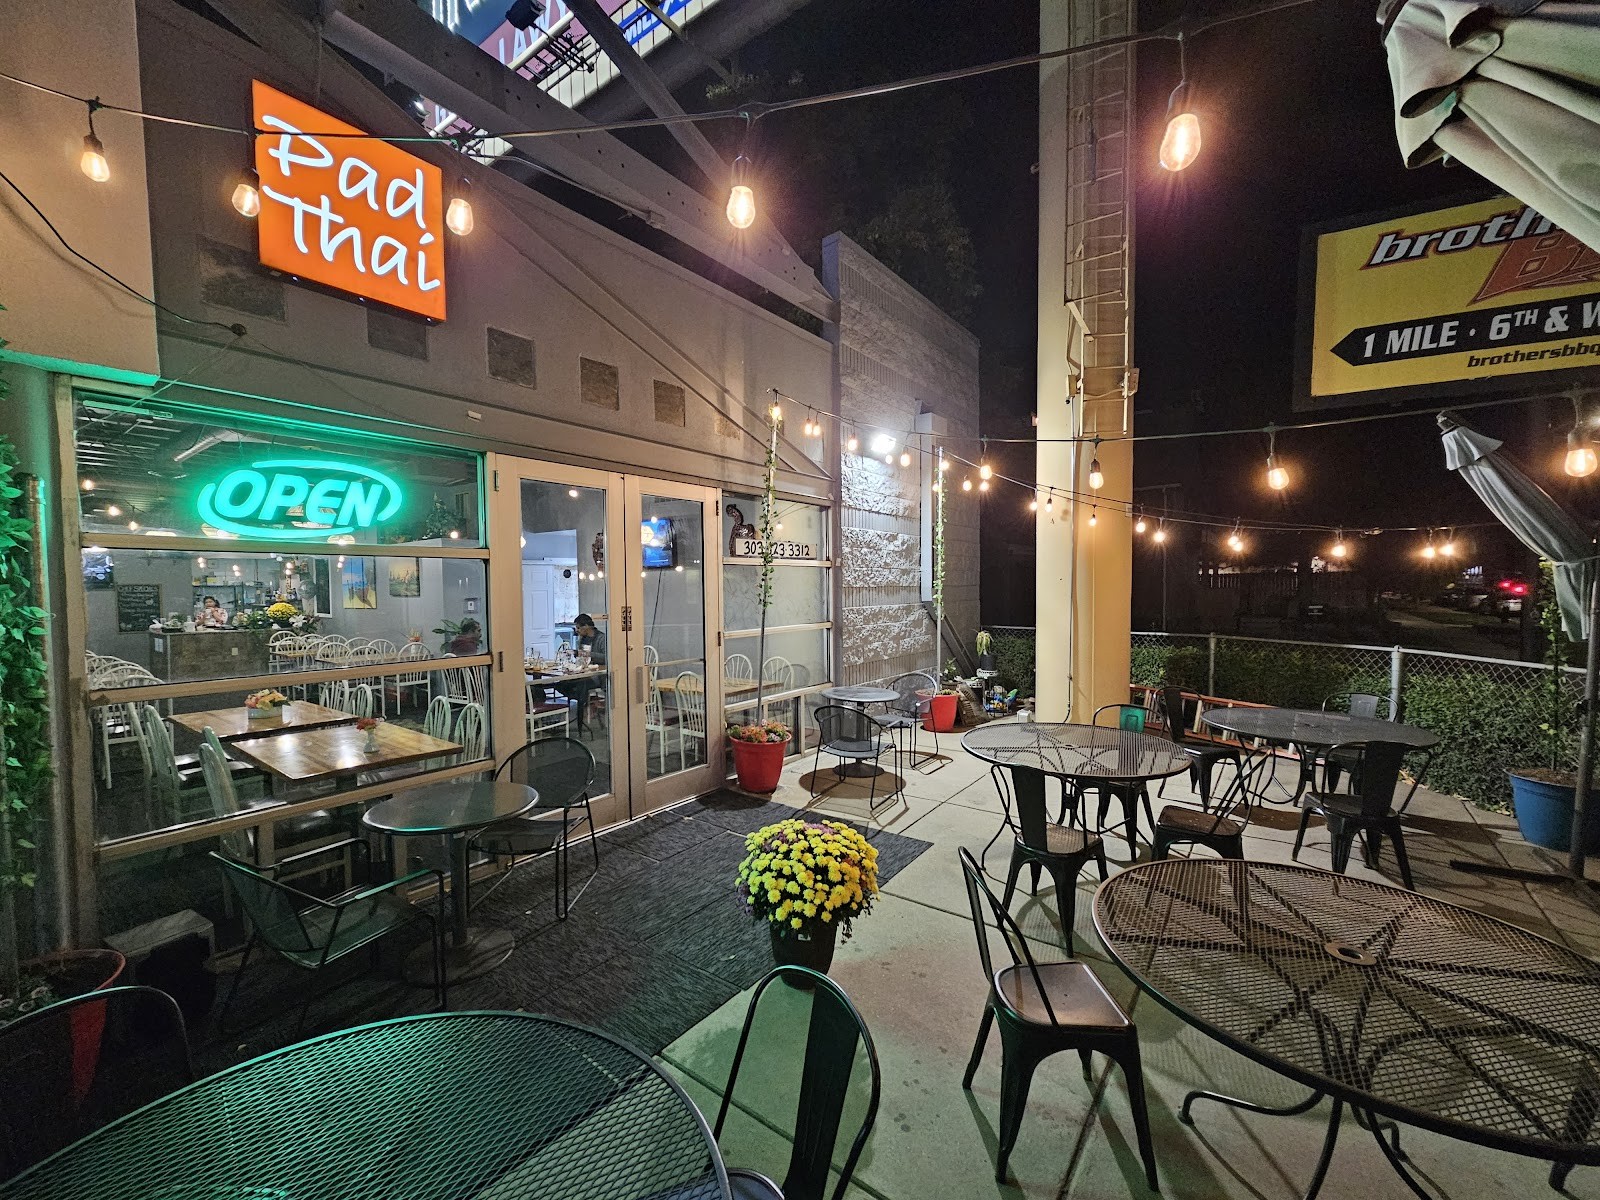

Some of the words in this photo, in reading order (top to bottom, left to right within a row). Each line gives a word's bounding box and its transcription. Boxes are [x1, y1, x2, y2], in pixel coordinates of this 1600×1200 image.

[262, 115, 426, 229] Pad
[262, 185, 441, 291] Thai
[1369, 206, 1562, 266] broth
[1363, 333, 1377, 358] 1
[1384, 320, 1460, 355] MILE
[1489, 308, 1539, 341] 6TH
[1544, 305, 1570, 334] &
[215, 469, 384, 527] OPEN
